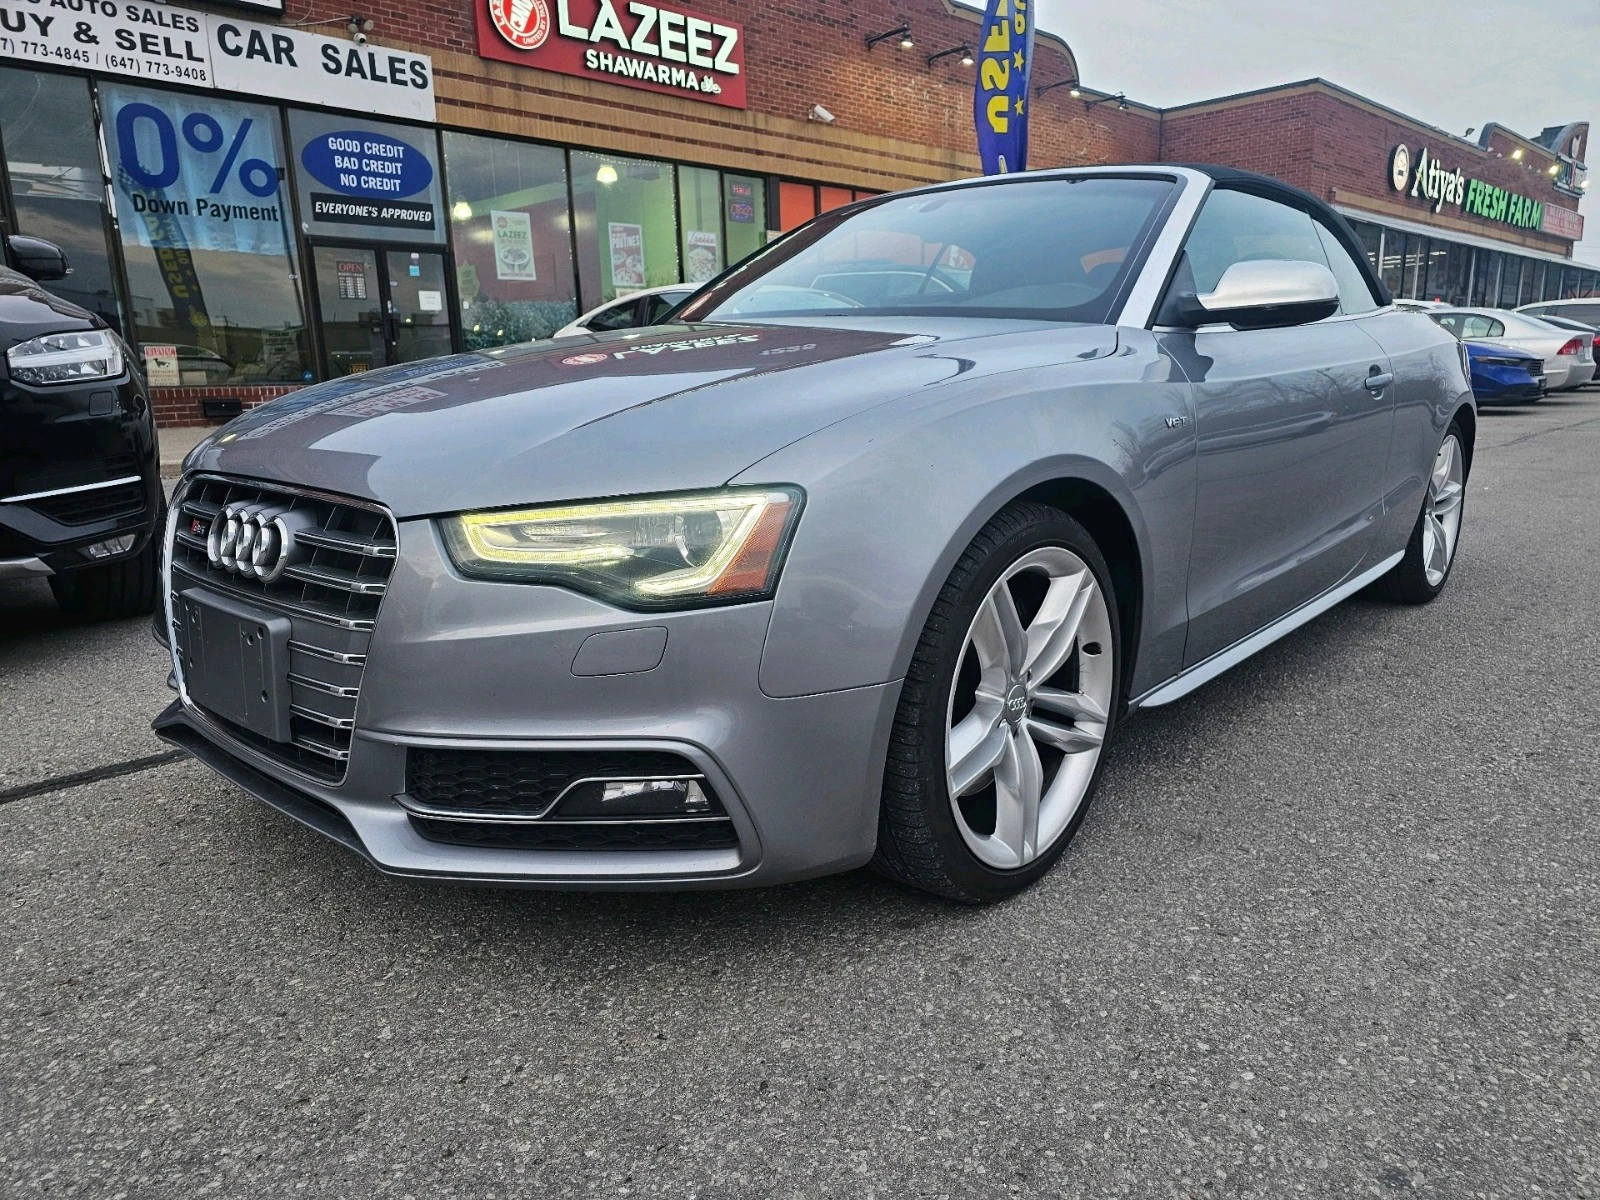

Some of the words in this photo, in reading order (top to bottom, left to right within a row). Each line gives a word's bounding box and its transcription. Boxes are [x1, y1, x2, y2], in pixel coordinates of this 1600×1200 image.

[50, 0, 118, 17] AUTO
[126, 5, 200, 33] SALES
[73, 21, 100, 46] &
[115, 28, 205, 63] SELL
[216, 23, 298, 67] CAR
[321, 43, 429, 90] SALES
[556, 0, 740, 76] LAZEEZ
[21, 41, 90, 63] 773-4845
[105, 53, 141, 74] (647)
[146, 60, 207, 82] 773-9408
[586, 48, 699, 91] SHAWARMA
[116, 102, 281, 197] 0%
[328, 137, 360, 153] GOOD
[364, 142, 404, 158] CREDIT
[334, 155, 358, 170] BAD
[362, 159, 402, 175] CREDIT
[340, 173, 357, 187] NO
[360, 176, 400, 192] CREDIT
[1411, 147, 1465, 214] Atiya's
[132, 193, 189, 215] Down
[196, 198, 280, 222] Payment
[315, 201, 378, 218] EVERYONE'S
[380, 207, 432, 222] APPROVED
[1465, 178, 1509, 222] FRESH
[1508, 193, 1541, 230] FARM
[497, 230, 528, 239] LAZEEZ
[338, 262, 363, 272] OPEN
